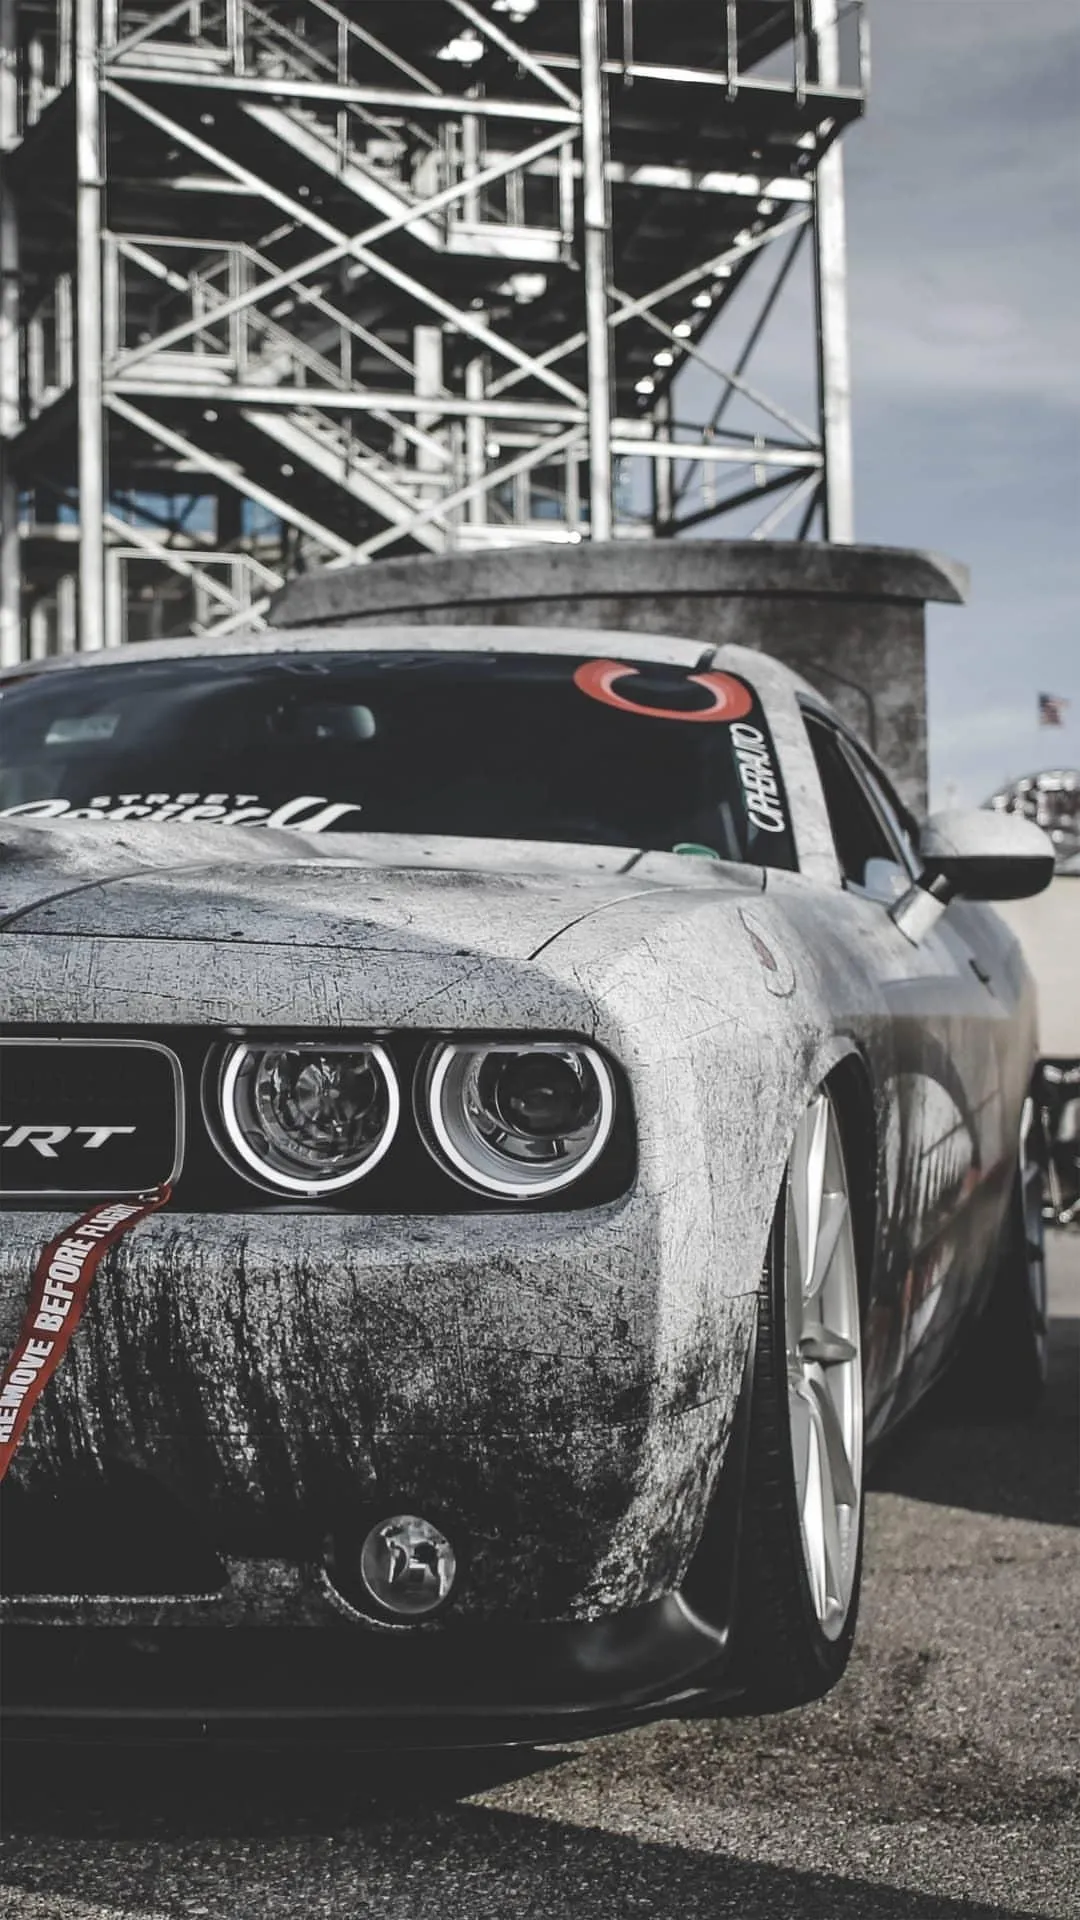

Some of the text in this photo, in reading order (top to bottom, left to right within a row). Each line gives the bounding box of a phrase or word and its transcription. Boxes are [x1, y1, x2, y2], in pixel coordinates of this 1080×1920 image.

[90, 793, 259, 808] STREET
[0, 1126, 137, 1158] RT
[33, 1237, 96, 1333] BEFORE
[75, 1203, 145, 1238] FLIGHT
